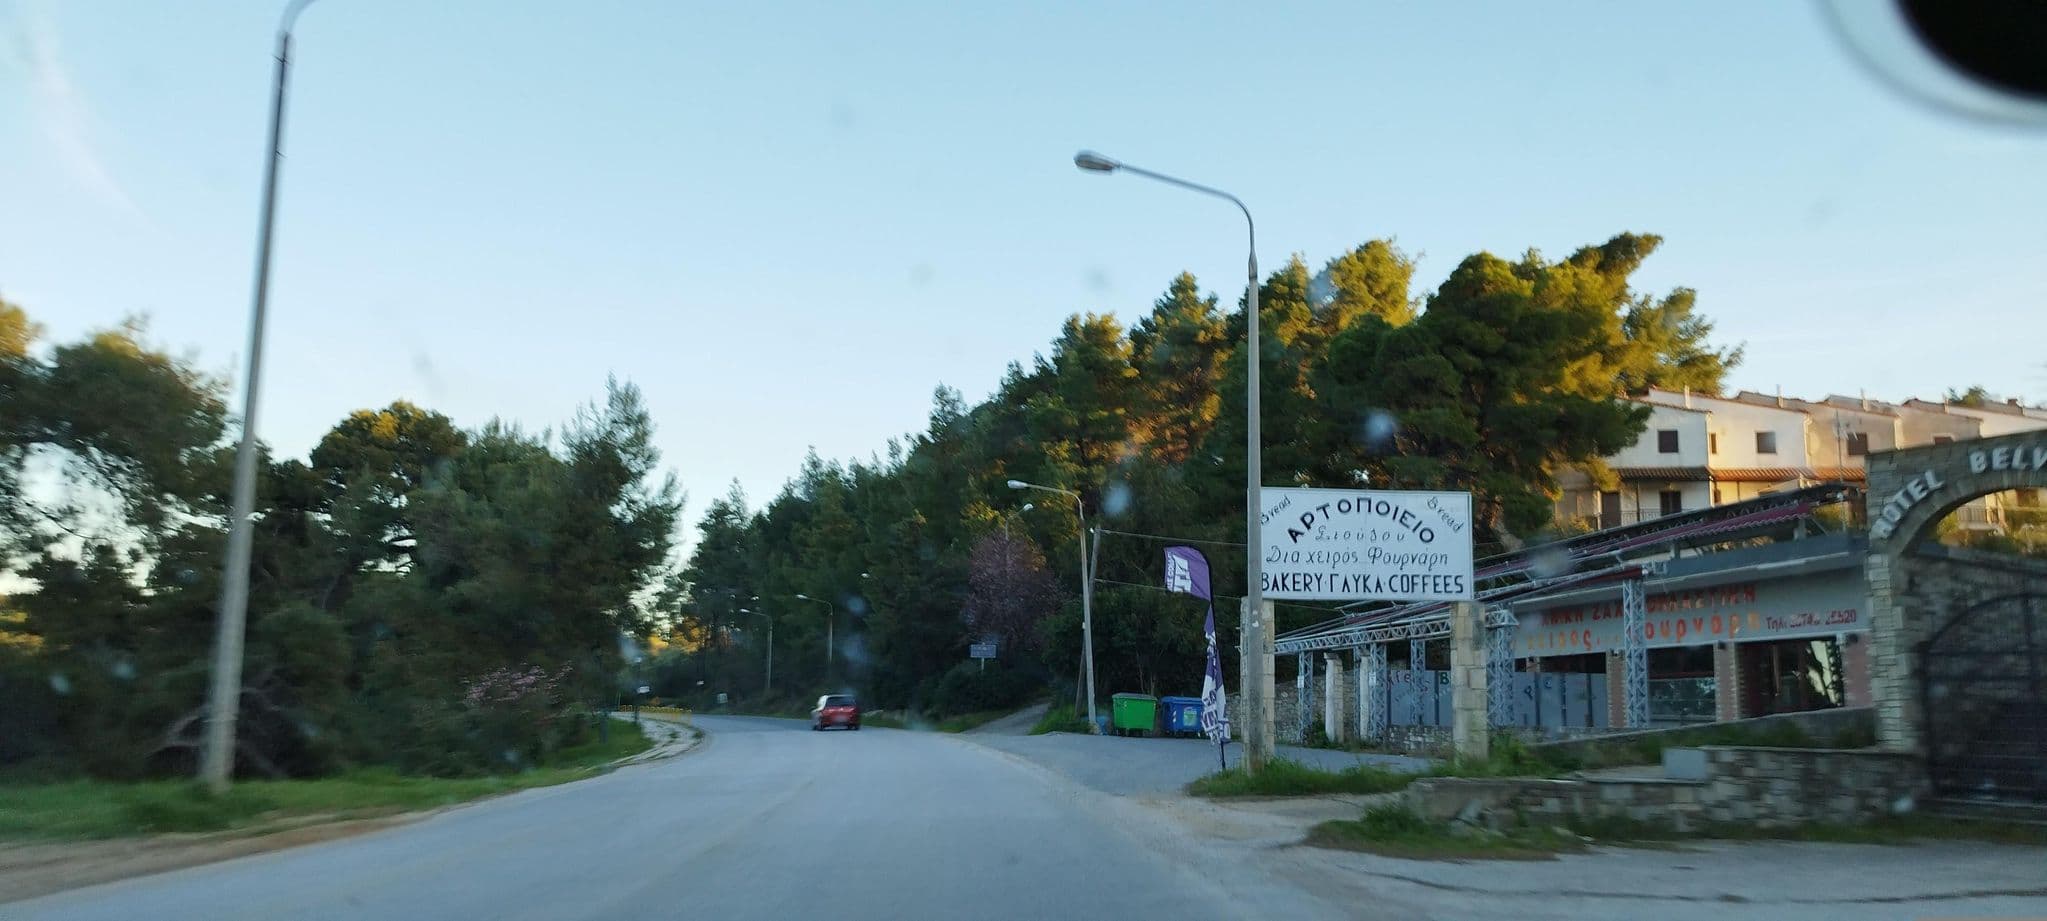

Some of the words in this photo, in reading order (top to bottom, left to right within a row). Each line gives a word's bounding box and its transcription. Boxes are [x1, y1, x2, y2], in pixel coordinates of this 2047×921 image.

[1287, 497, 1435, 544] ΑΡΤΟΠΟΙΕΙΟ
[1427, 496, 1464, 533] Bread
[1869, 469, 1945, 539] HOTEL
[1266, 545, 1300, 564] Δια
[1306, 546, 1358, 568] χειρός
[1367, 546, 1448, 571] Φουρνάρη
[1261, 571, 1323, 592] BAKERY
[1389, 573, 1464, 594] COFFEES
